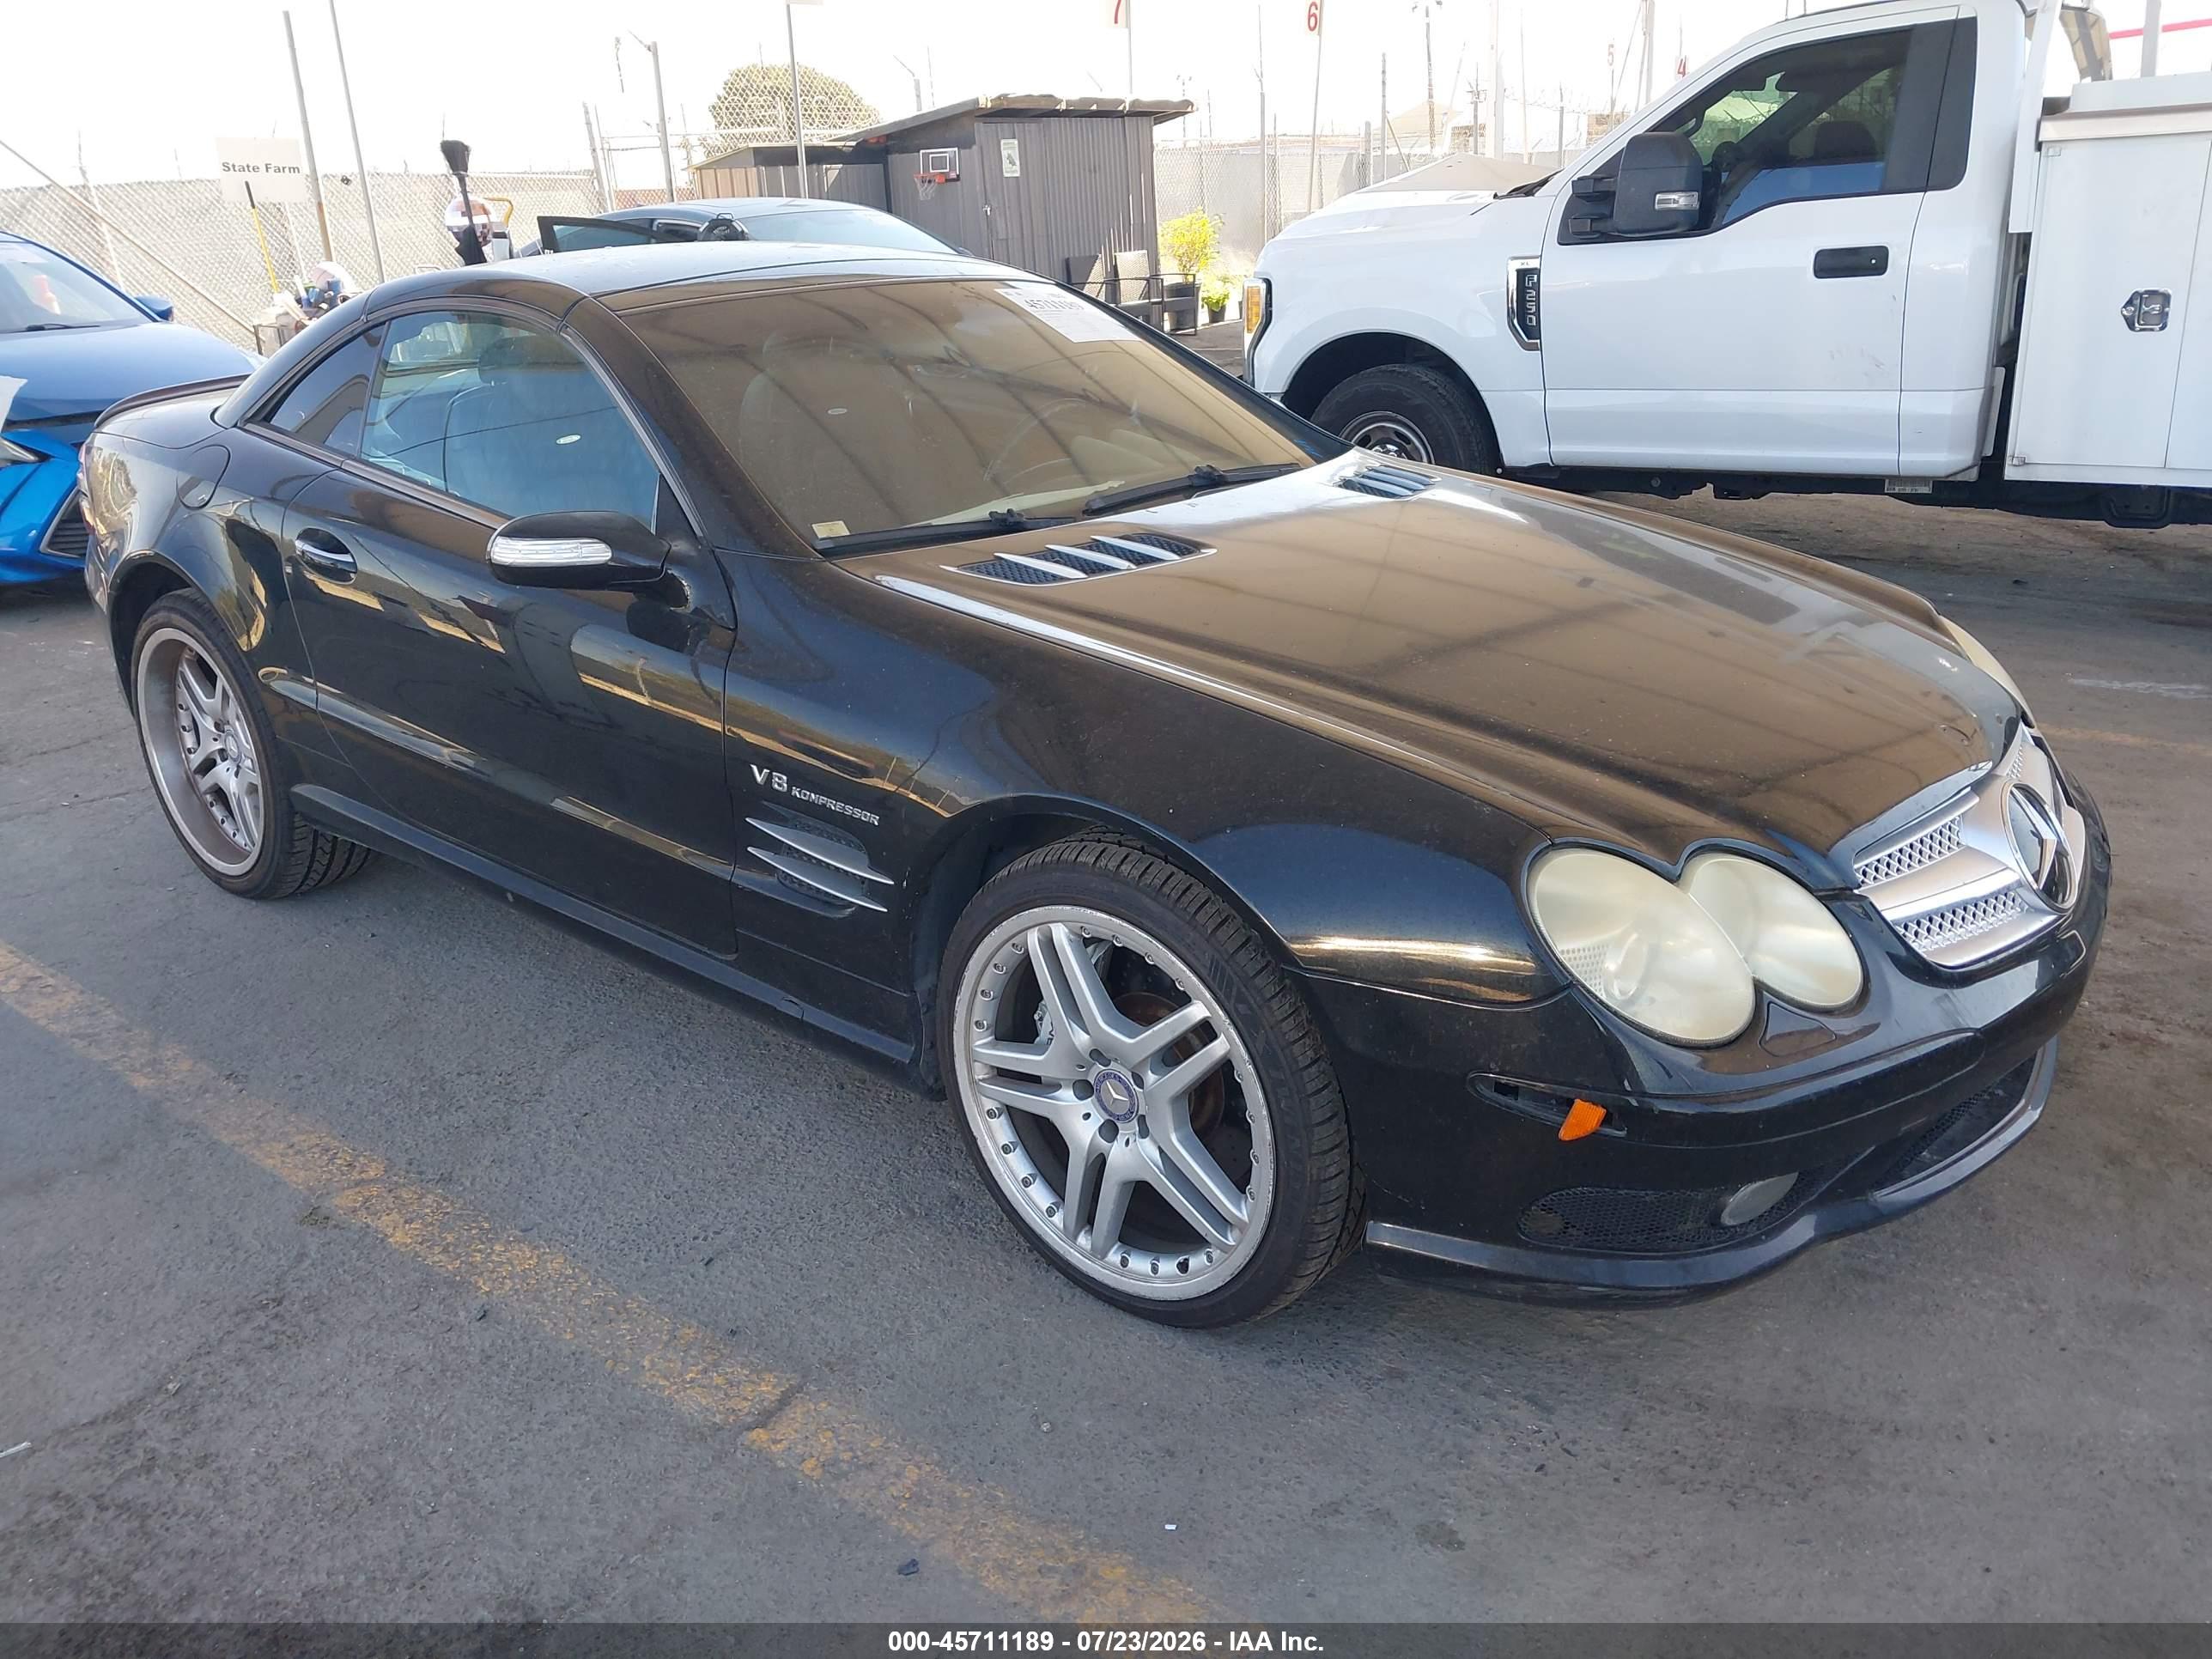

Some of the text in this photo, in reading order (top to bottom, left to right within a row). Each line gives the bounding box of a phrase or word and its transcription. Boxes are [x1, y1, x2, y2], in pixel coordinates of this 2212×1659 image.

[1308, 1, 1318, 32] 6
[1607, 44, 1614, 66] 5
[1677, 56, 1687, 78] 4
[222, 161, 301, 173] State Farm
[750, 763, 787, 793] V8
